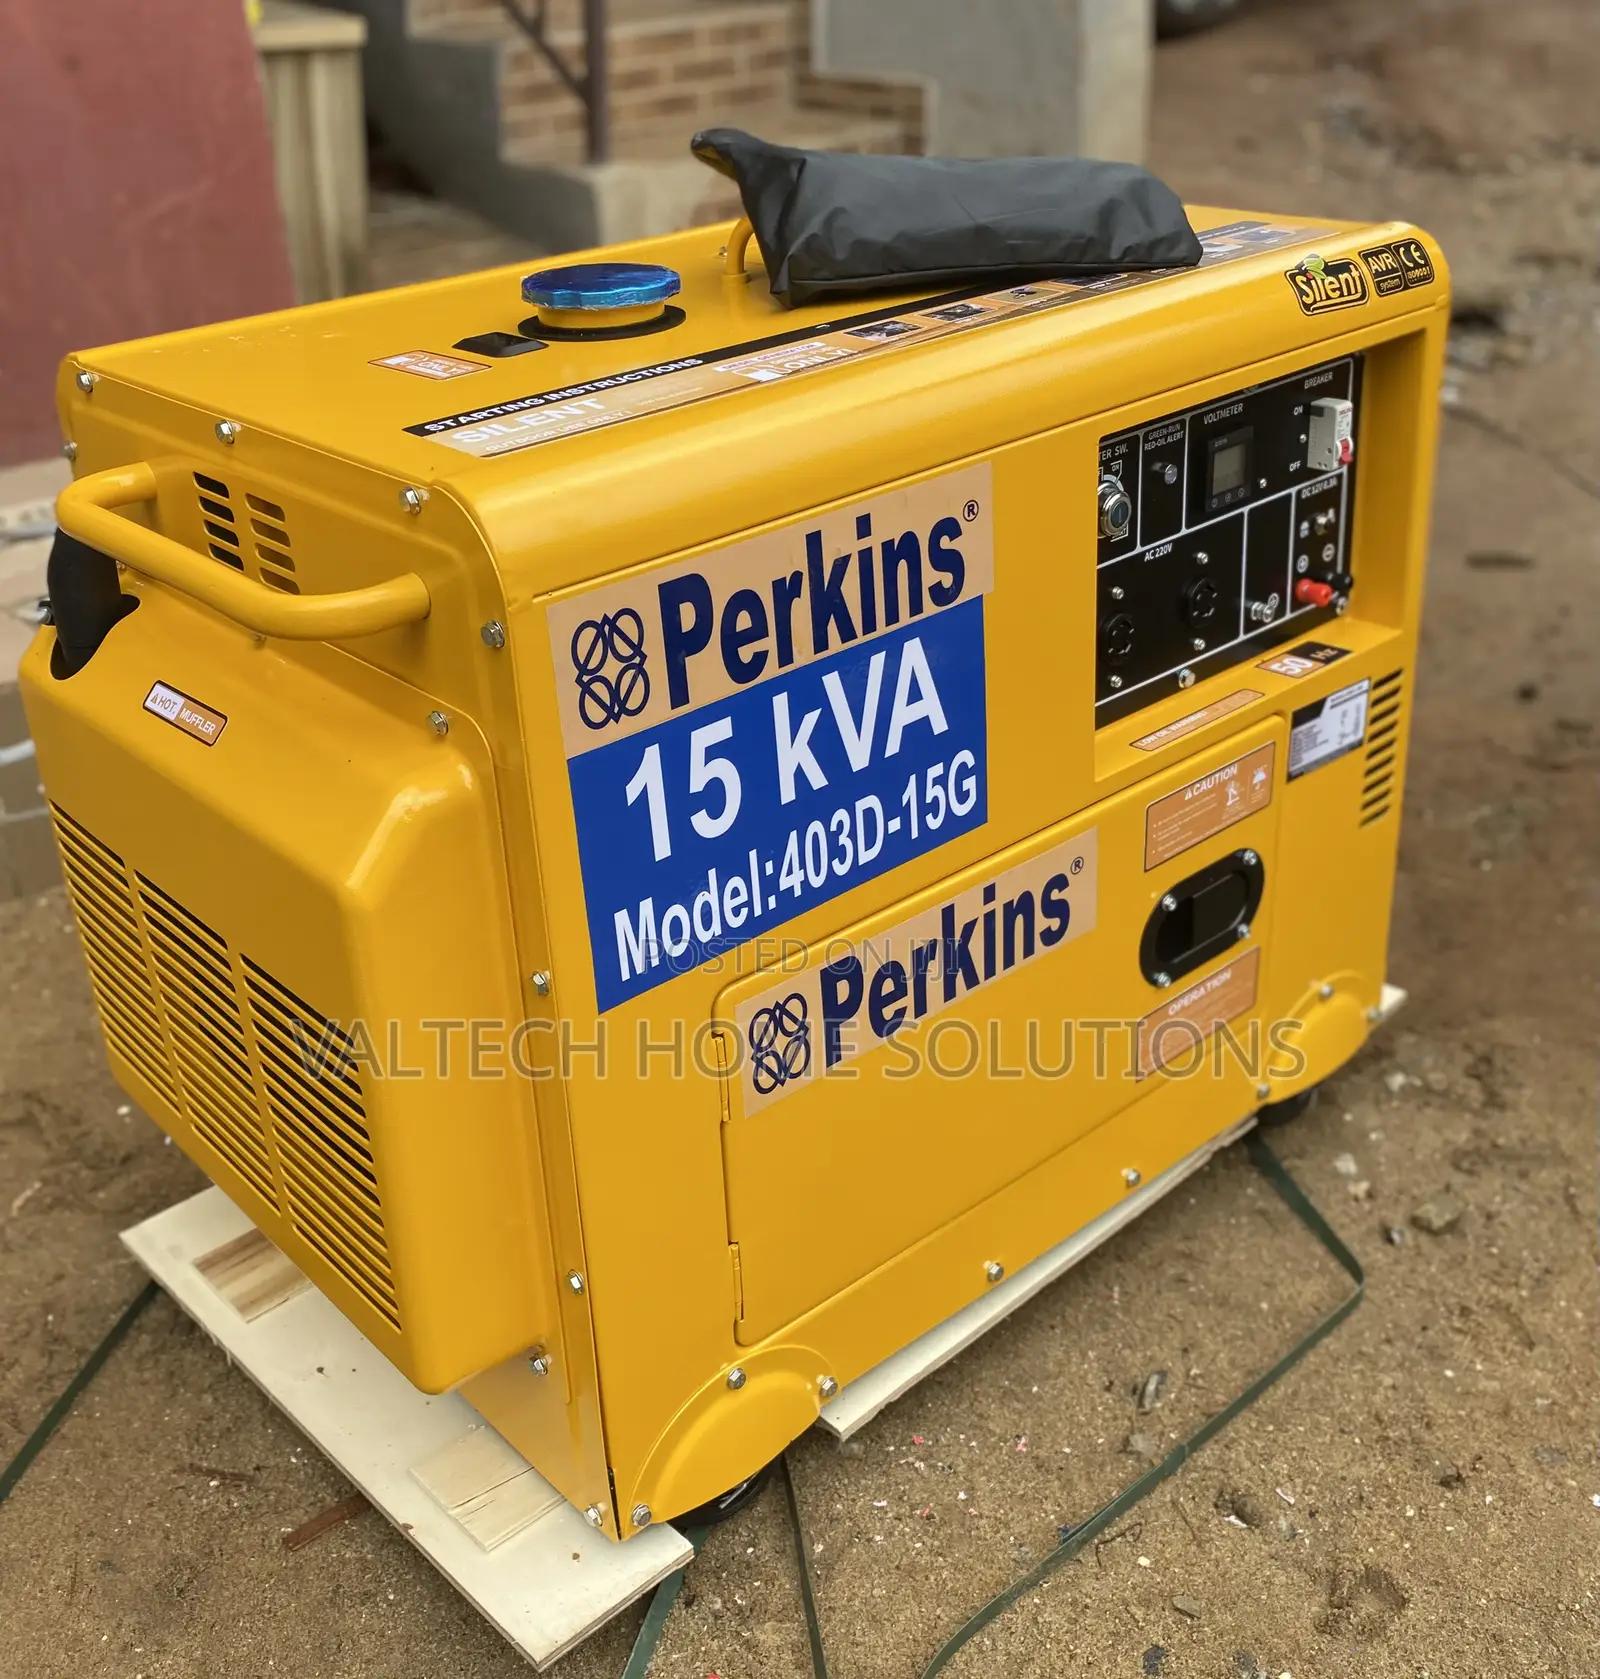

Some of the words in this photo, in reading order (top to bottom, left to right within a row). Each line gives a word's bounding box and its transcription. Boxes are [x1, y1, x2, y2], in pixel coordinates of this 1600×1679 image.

[1368, 253, 1396, 273] AVR
[1400, 244, 1424, 267] CE
[1296, 265, 1362, 304] Silent
[1380, 278, 1400, 291] system
[1304, 372, 1333, 390] BREAKER
[424, 397, 545, 433] STARTING
[543, 358, 704, 402] INSTRUCTIONS
[1204, 403, 1243, 424] VOLTMETER
[1294, 406, 1303, 415] ON
[451, 398, 607, 444] SILENT
[485, 430, 555, 451] OUTDOOR
[1144, 437, 1166, 451] RED-OIL
[1167, 431, 1184, 444] ALERT
[1148, 423, 1180, 440] GREEN-RUN
[1115, 443, 1128, 456] SW.
[1112, 464, 1119, 472] ON
[1289, 461, 1301, 472] OFF
[1301, 486, 1311, 498] DC
[1144, 550, 1154, 562] AC
[1155, 543, 1172, 558] 220V
[1270, 656, 1313, 675] 50
[1311, 645, 1339, 660] Hz
[180, 708, 216, 735] MUFFLER
[625, 716, 742, 862] 15
[772, 636, 949, 805] kVA
[1193, 763, 1239, 796] CAUTION
[1168, 968, 1232, 1016] OPERATION
